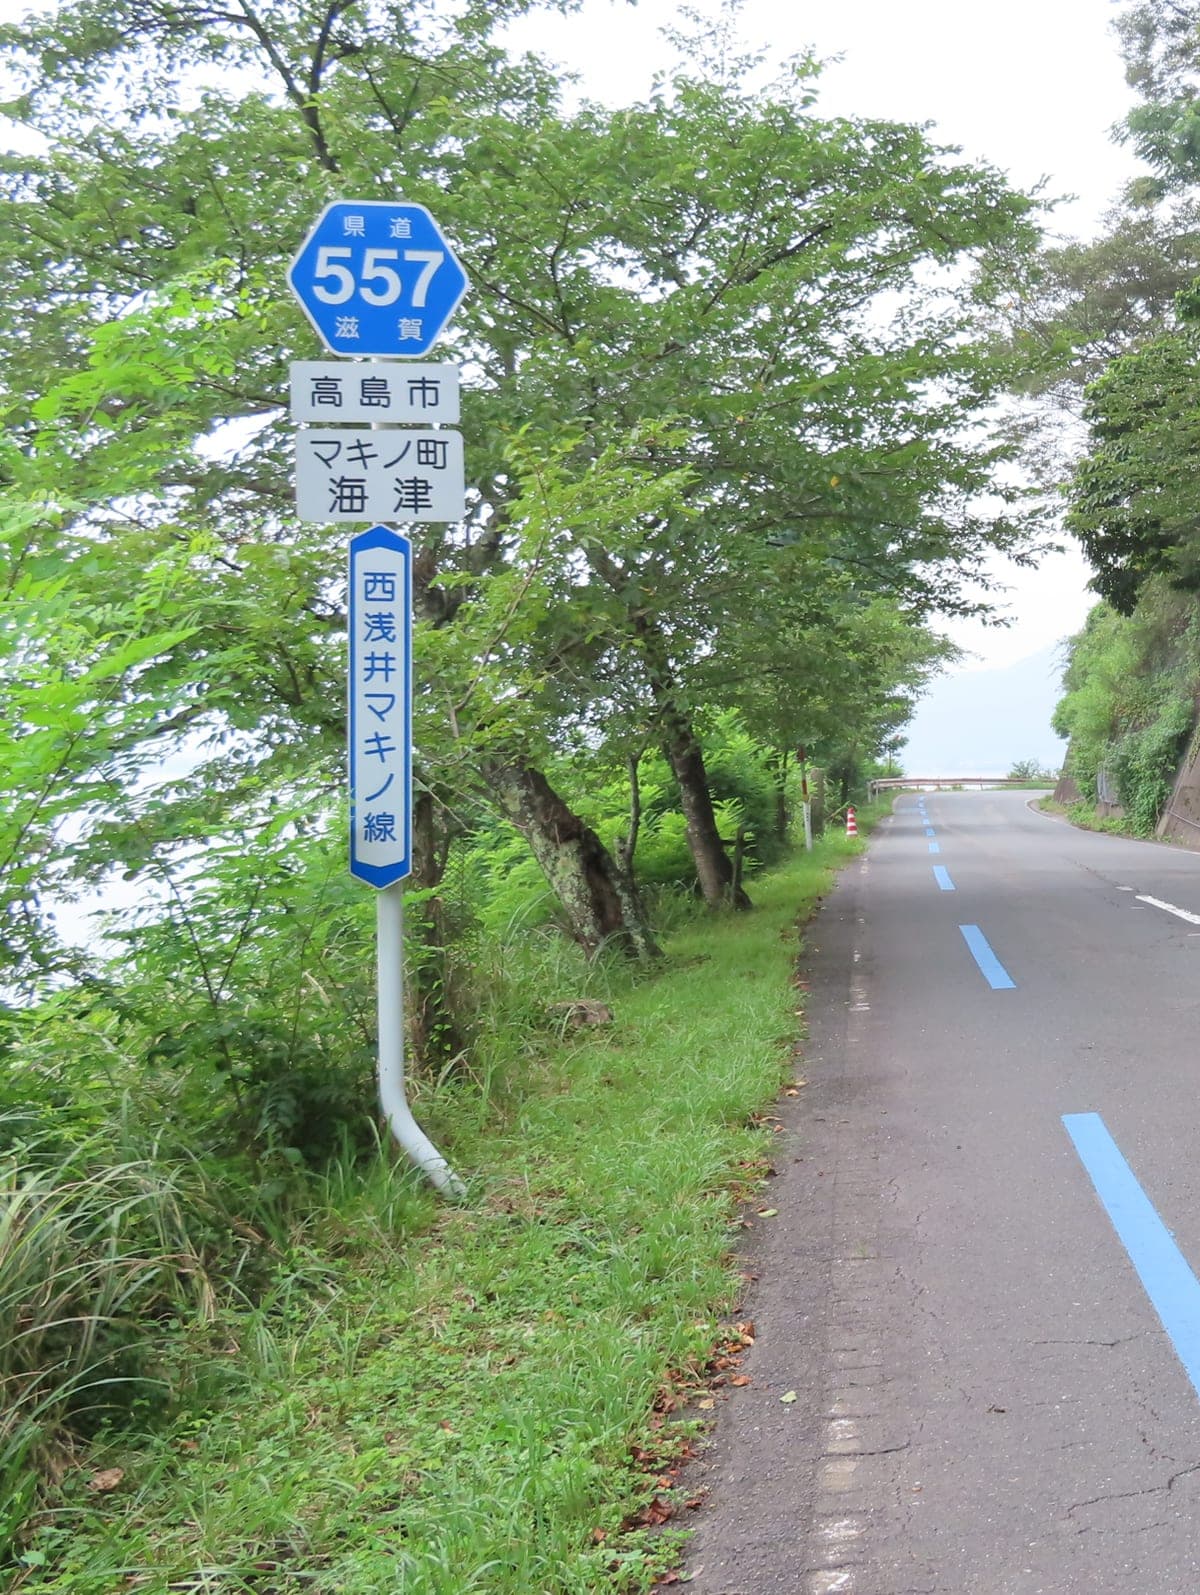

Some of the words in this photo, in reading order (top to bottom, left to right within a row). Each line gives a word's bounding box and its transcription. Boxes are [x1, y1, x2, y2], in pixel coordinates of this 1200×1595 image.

[343, 215, 413, 239] 県道
[312, 246, 445, 308] 557
[335, 316, 423, 341] 滋賀
[310, 376, 441, 409] 高島市
[309, 438, 449, 470] マキノ町
[328, 475, 434, 515] 海津
[363, 571, 397, 843] 西浅井マキノ線
